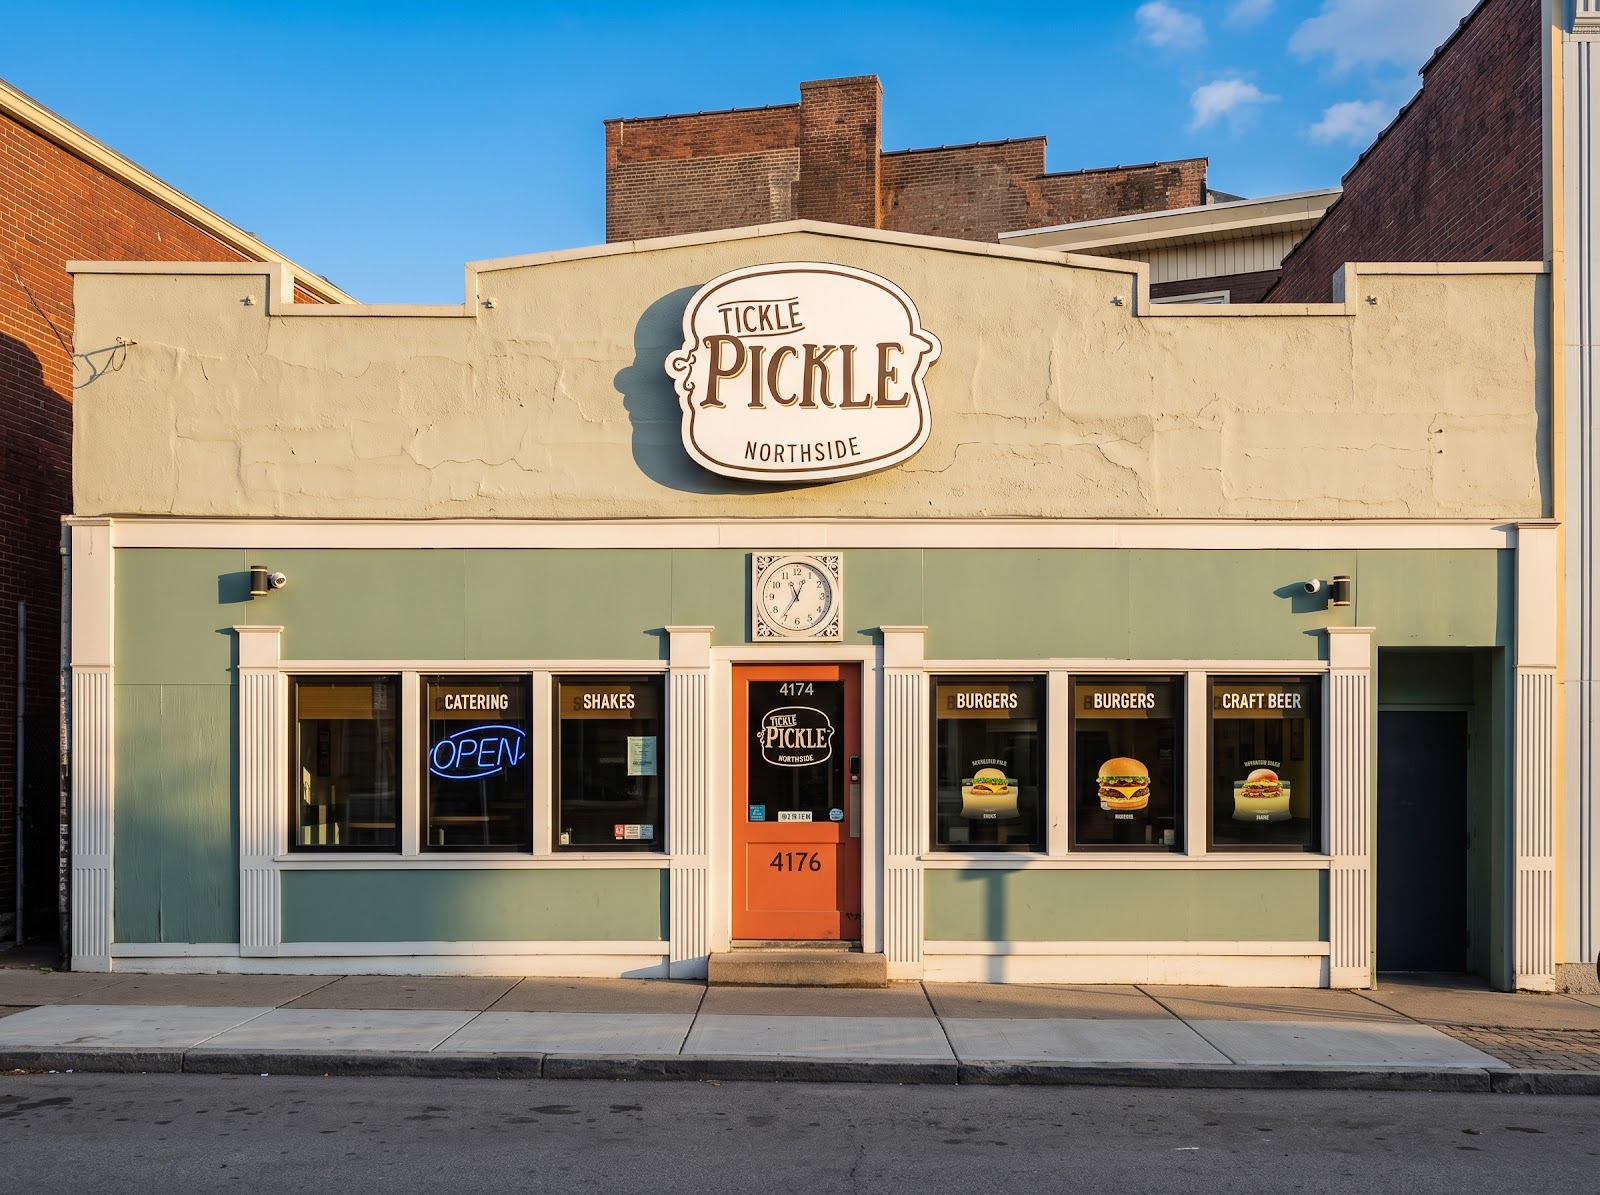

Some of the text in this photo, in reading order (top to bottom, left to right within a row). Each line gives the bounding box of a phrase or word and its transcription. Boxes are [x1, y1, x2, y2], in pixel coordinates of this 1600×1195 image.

[718, 301, 803, 334] TICKLE
[700, 334, 911, 409] PICKLE
[744, 436, 861, 463] NORTHSIDE
[779, 682, 814, 696] 4174
[444, 694, 509, 710] CATERING
[583, 693, 635, 709] SHAKES
[956, 692, 1018, 709] BURGERS
[1094, 692, 1155, 709] BURGERS
[1222, 693, 1302, 709] CRAFT BEER
[770, 714, 797, 727] TICKLE
[765, 726, 827, 749] PICKLE
[433, 736, 521, 770] OPEN
[778, 754, 814, 763] NORTHSIDE
[770, 852, 822, 872] 4176
